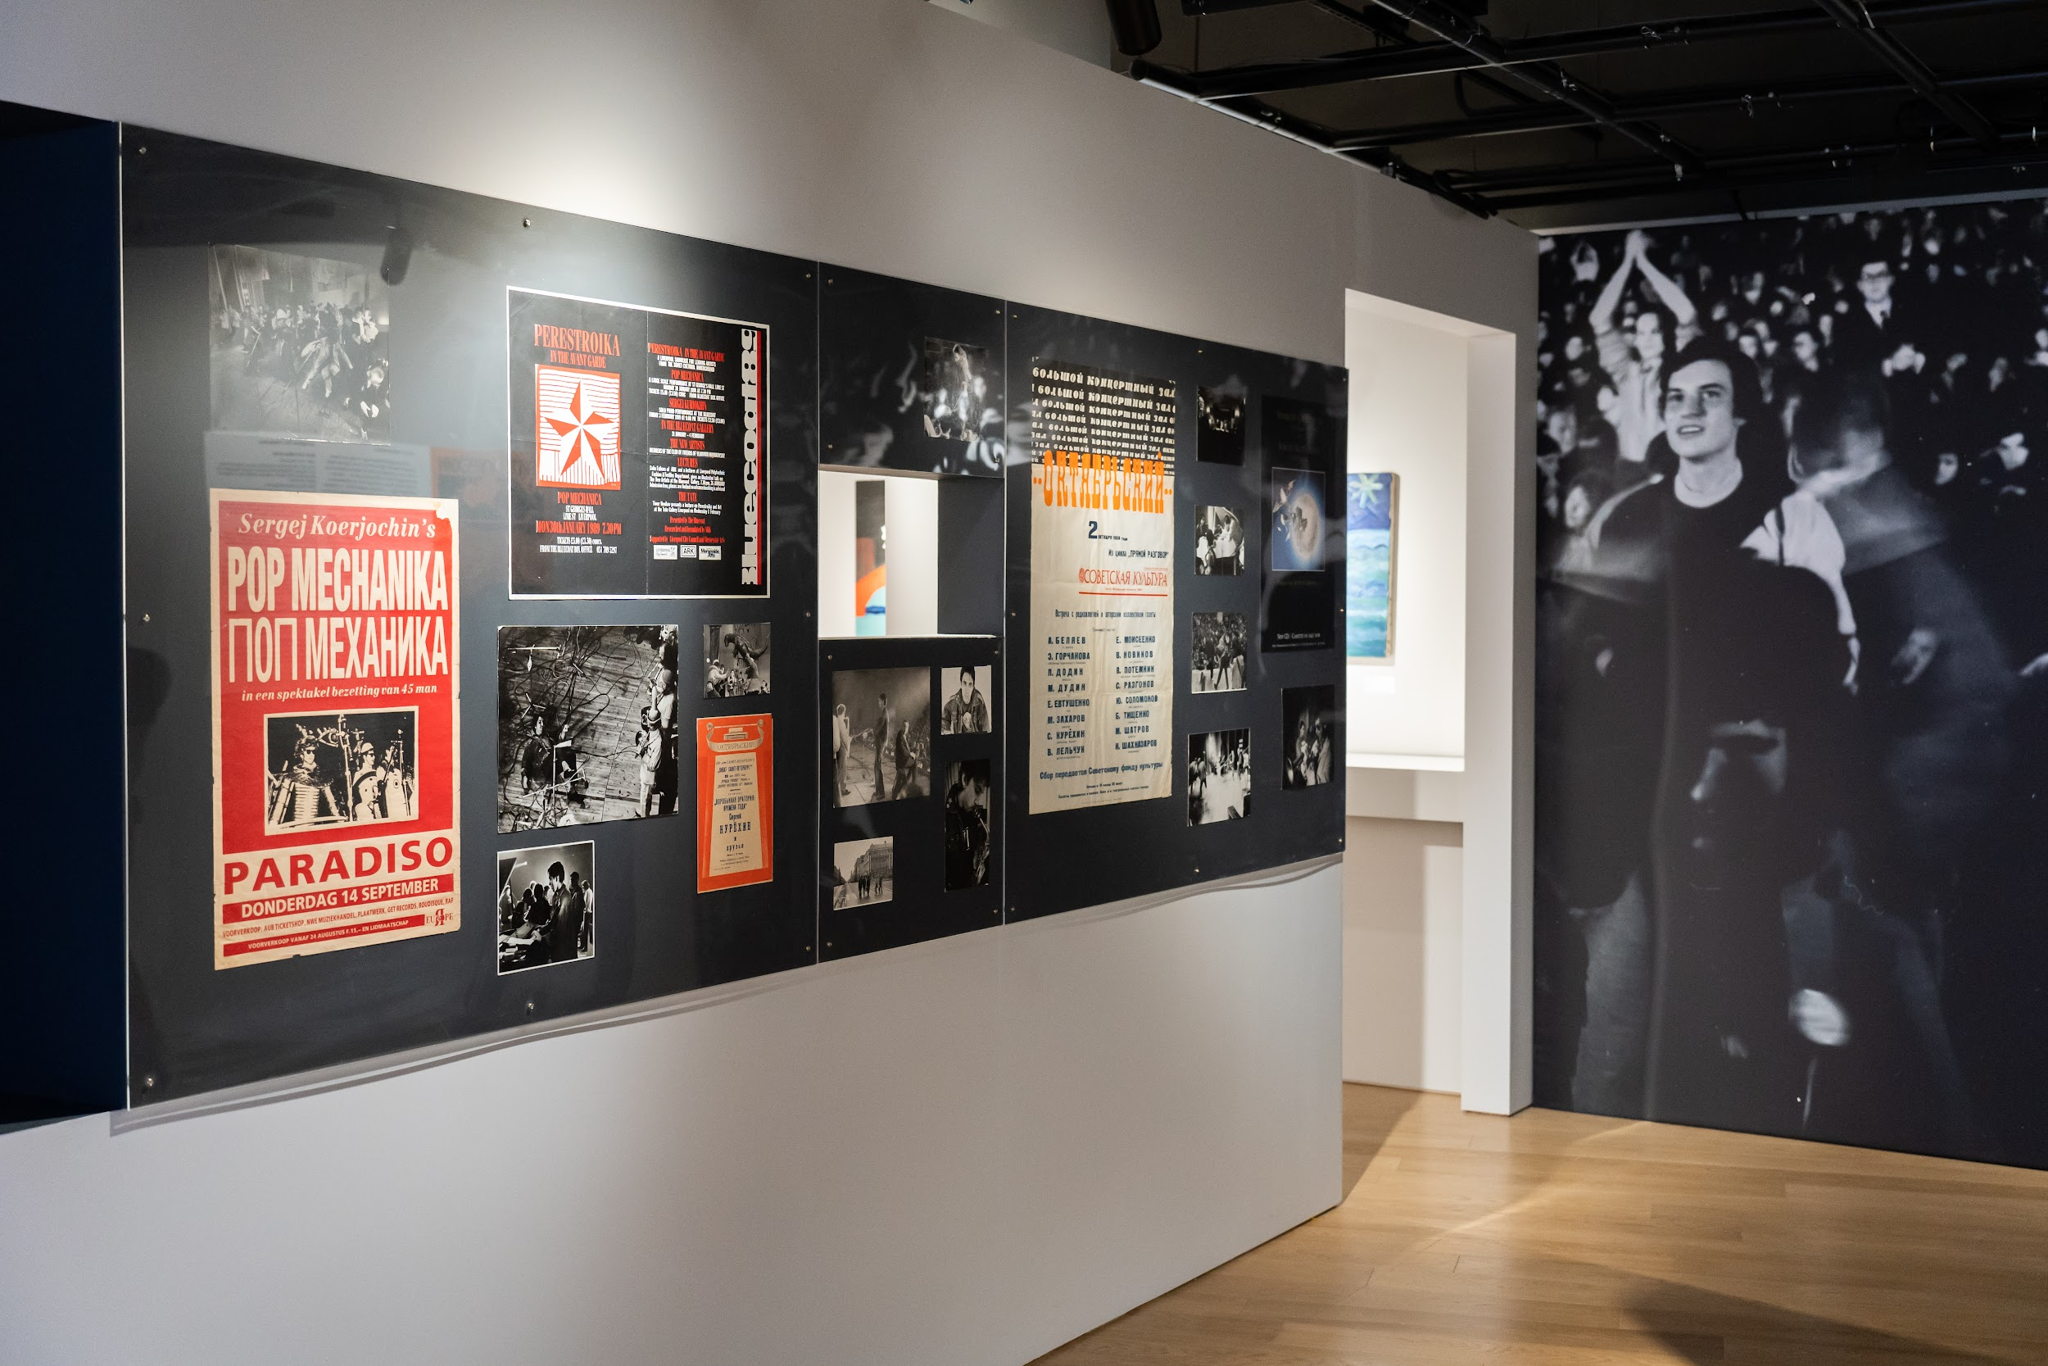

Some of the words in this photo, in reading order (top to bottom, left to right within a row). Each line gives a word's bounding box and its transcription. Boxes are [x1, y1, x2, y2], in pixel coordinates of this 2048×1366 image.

[534, 324, 620, 356] PERESTROIKA
[238, 513, 307, 539] Sergej
[1088, 521, 1098, 539] 2
[228, 546, 285, 613] POP
[292, 547, 448, 611] MECHANIKA
[1084, 569, 1130, 585] СОВЕТСКАЯ
[1133, 571, 1168, 586] КУЛЬТУРА
[229, 617, 297, 684] ПОП
[305, 616, 448, 680] МЕХАНИКА
[1056, 668, 1083, 677] ДОДИН
[242, 690, 253, 701] in
[255, 692, 274, 700] een
[277, 686, 330, 702] spektakel
[332, 685, 380, 698] bezetting
[382, 686, 400, 695] van
[402, 684, 414, 695] 45
[416, 685, 437, 694] man
[1058, 684, 1085, 692] ДУДИН
[1057, 715, 1085, 723] ЗАХАРОВ
[224, 836, 453, 895] PARADISO
[242, 892, 337, 918] DONDERDAG
[342, 889, 358, 904] 14
[362, 878, 438, 902] SEPTEMBER
